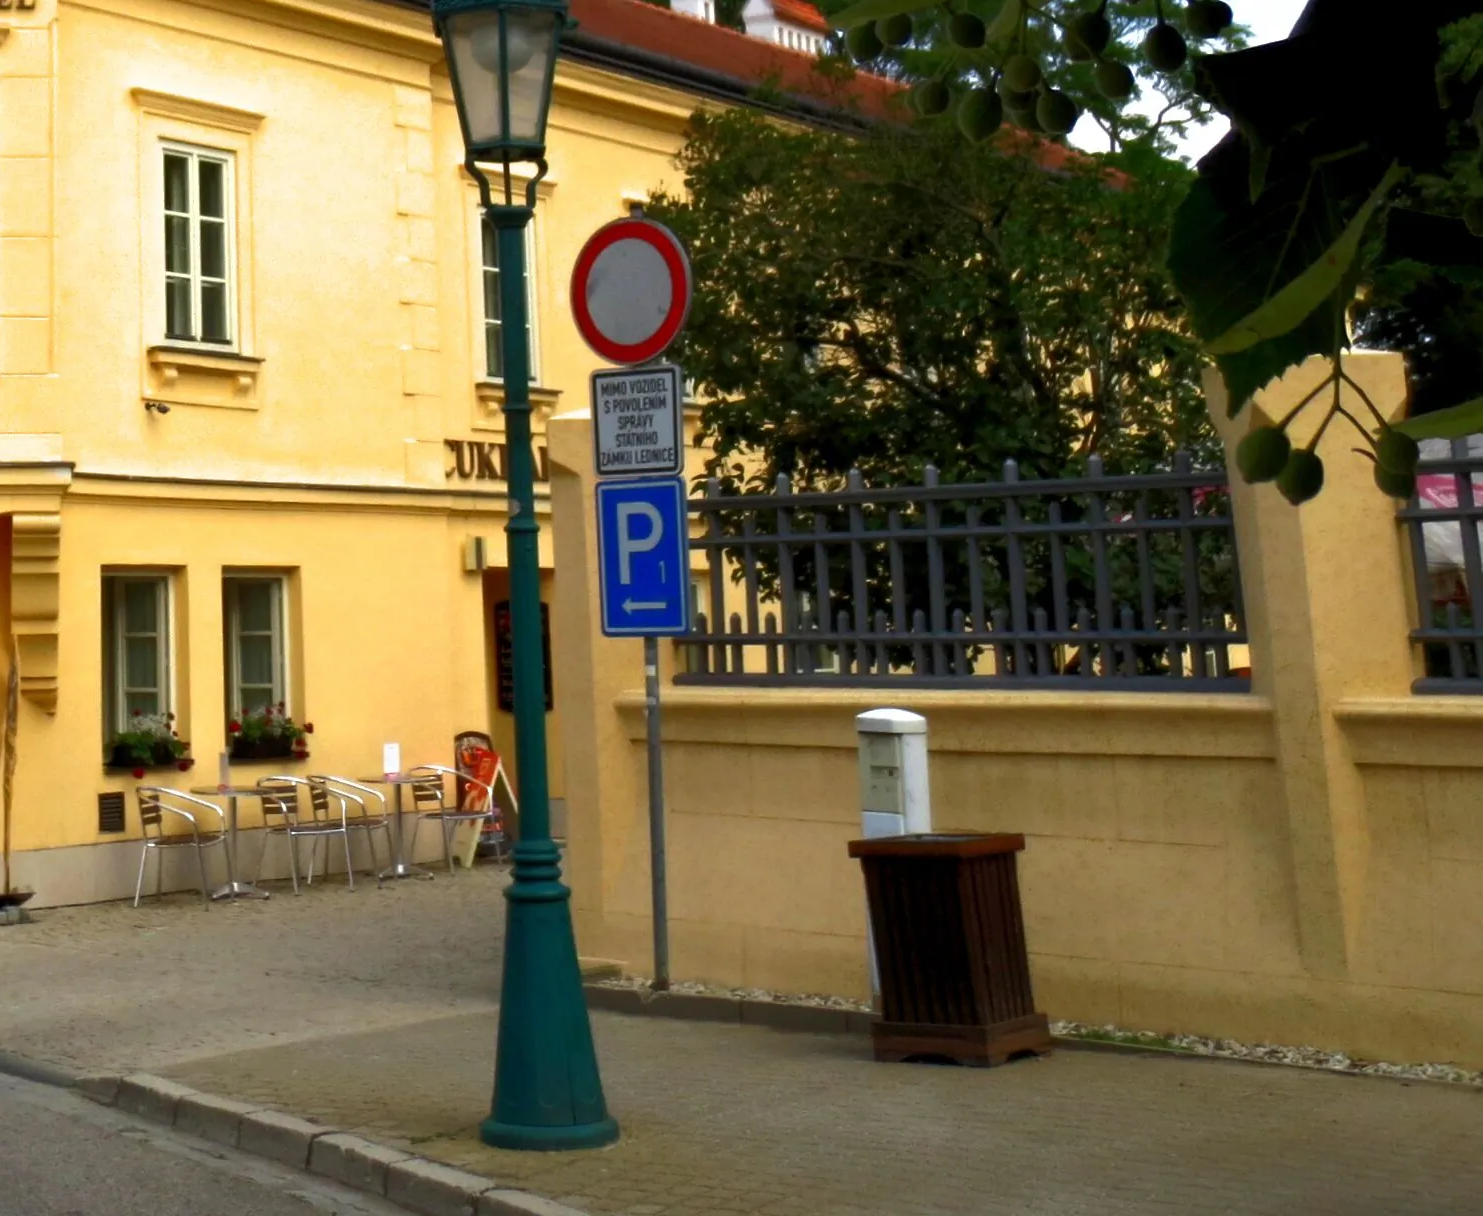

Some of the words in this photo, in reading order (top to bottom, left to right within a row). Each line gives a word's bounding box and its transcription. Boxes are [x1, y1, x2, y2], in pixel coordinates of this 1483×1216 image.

[601, 381, 627, 397] MIMO
[629, 378, 668, 394] VOZIDEL
[604, 400, 611, 414] S
[613, 396, 667, 413] POVOLENÍM
[617, 413, 654, 430] SPRÁVY
[615, 429, 659, 447] STÁTNÍHO
[600, 448, 632, 466] ZÁMKU
[635, 447, 674, 464] LEDNICE
[616, 502, 664, 585] P
[659, 561, 666, 583] 1
